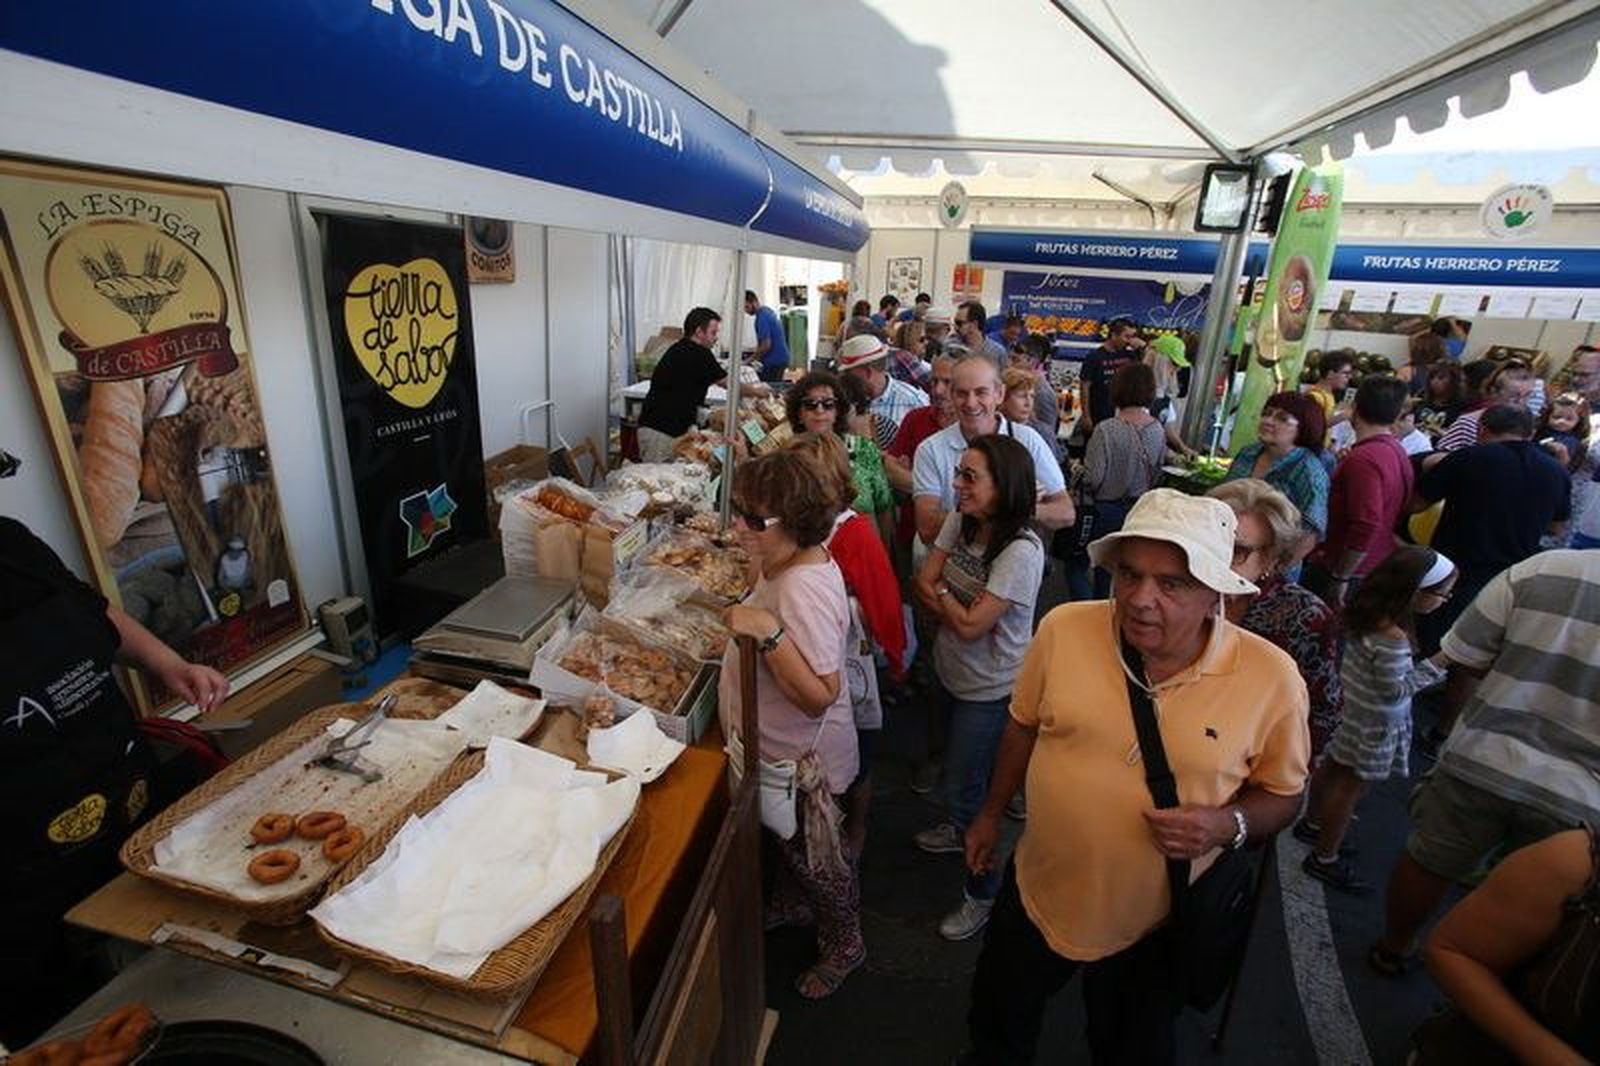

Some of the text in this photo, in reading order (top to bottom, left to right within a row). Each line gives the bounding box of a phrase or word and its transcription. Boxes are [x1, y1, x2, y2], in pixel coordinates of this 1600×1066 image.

[488, 2, 551, 88] DE
[559, 44, 683, 151] CASTILLA
[38, 193, 202, 247] LA ESPIGA
[1035, 242, 1178, 259] FRUTAS HERRERO PÉREZ
[1362, 255, 1562, 272] FRUTAS HERRERO PÉREZ
[346, 273, 455, 320] tierra
[87, 332, 221, 375] de CASTILLA
[363, 318, 398, 350] de
[376, 318, 462, 392] sabor
[376, 419, 424, 437] CASTILLA
[426, 415, 432, 425] Y
